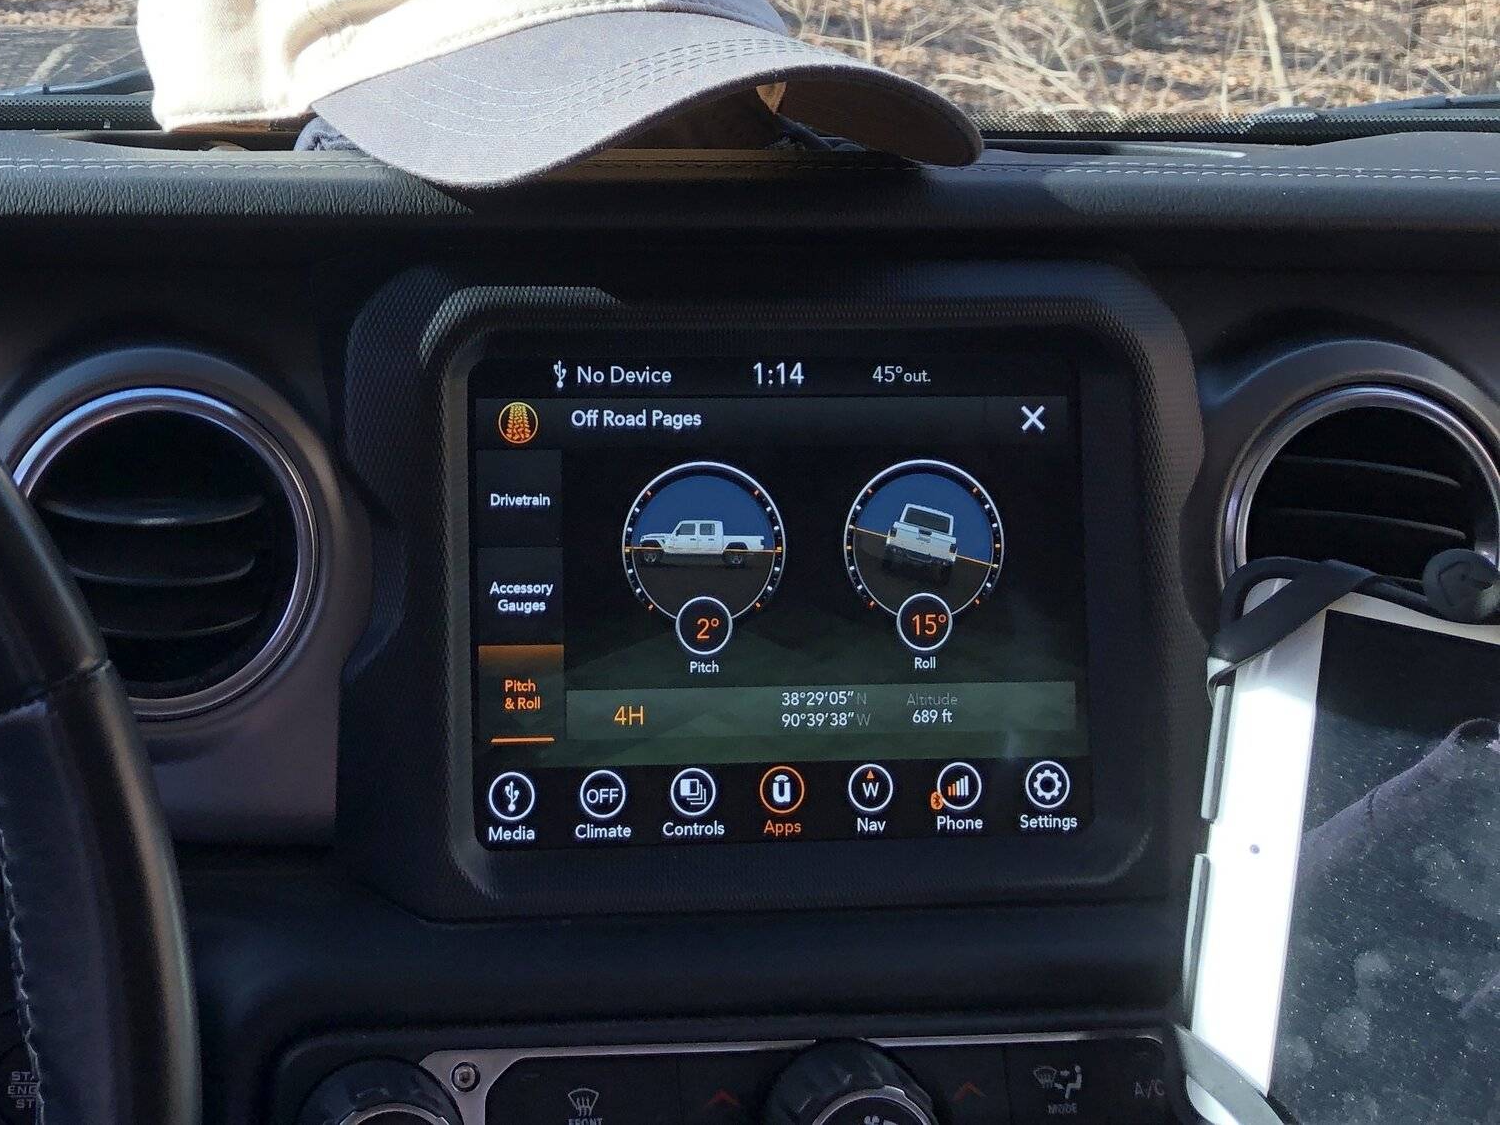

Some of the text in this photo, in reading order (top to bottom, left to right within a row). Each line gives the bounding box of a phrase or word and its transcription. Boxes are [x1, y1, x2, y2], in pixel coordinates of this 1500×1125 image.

[578, 366, 671, 383] No Device
[754, 363, 804, 384] 1:14
[572, 409, 701, 429] Off Road Pages
[491, 494, 550, 506] Drivetrain
[490, 582, 553, 601] Accessory
[498, 599, 546, 614] Gauges
[695, 617, 720, 641] 2°
[910, 613, 948, 637] 15°
[690, 660, 719, 673] Pitch
[915, 657, 935, 668] Roll
[504, 679, 536, 694] Pitch
[504, 696, 541, 711] & Roll
[906, 693, 958, 706] Altitude
[613, 706, 645, 726] 4H
[912, 709, 953, 724] 689 ft
[586, 788, 619, 803] OFF
[862, 782, 879, 797] W
[663, 820, 724, 836] Controls
[763, 819, 802, 836] Apps
[857, 818, 886, 832] Nav
[937, 815, 983, 830] Phone
[1020, 814, 1077, 830] Settings
[489, 825, 535, 841] Media
[575, 824, 631, 838] Climate
[1133, 1081, 1166, 1098] A/C
